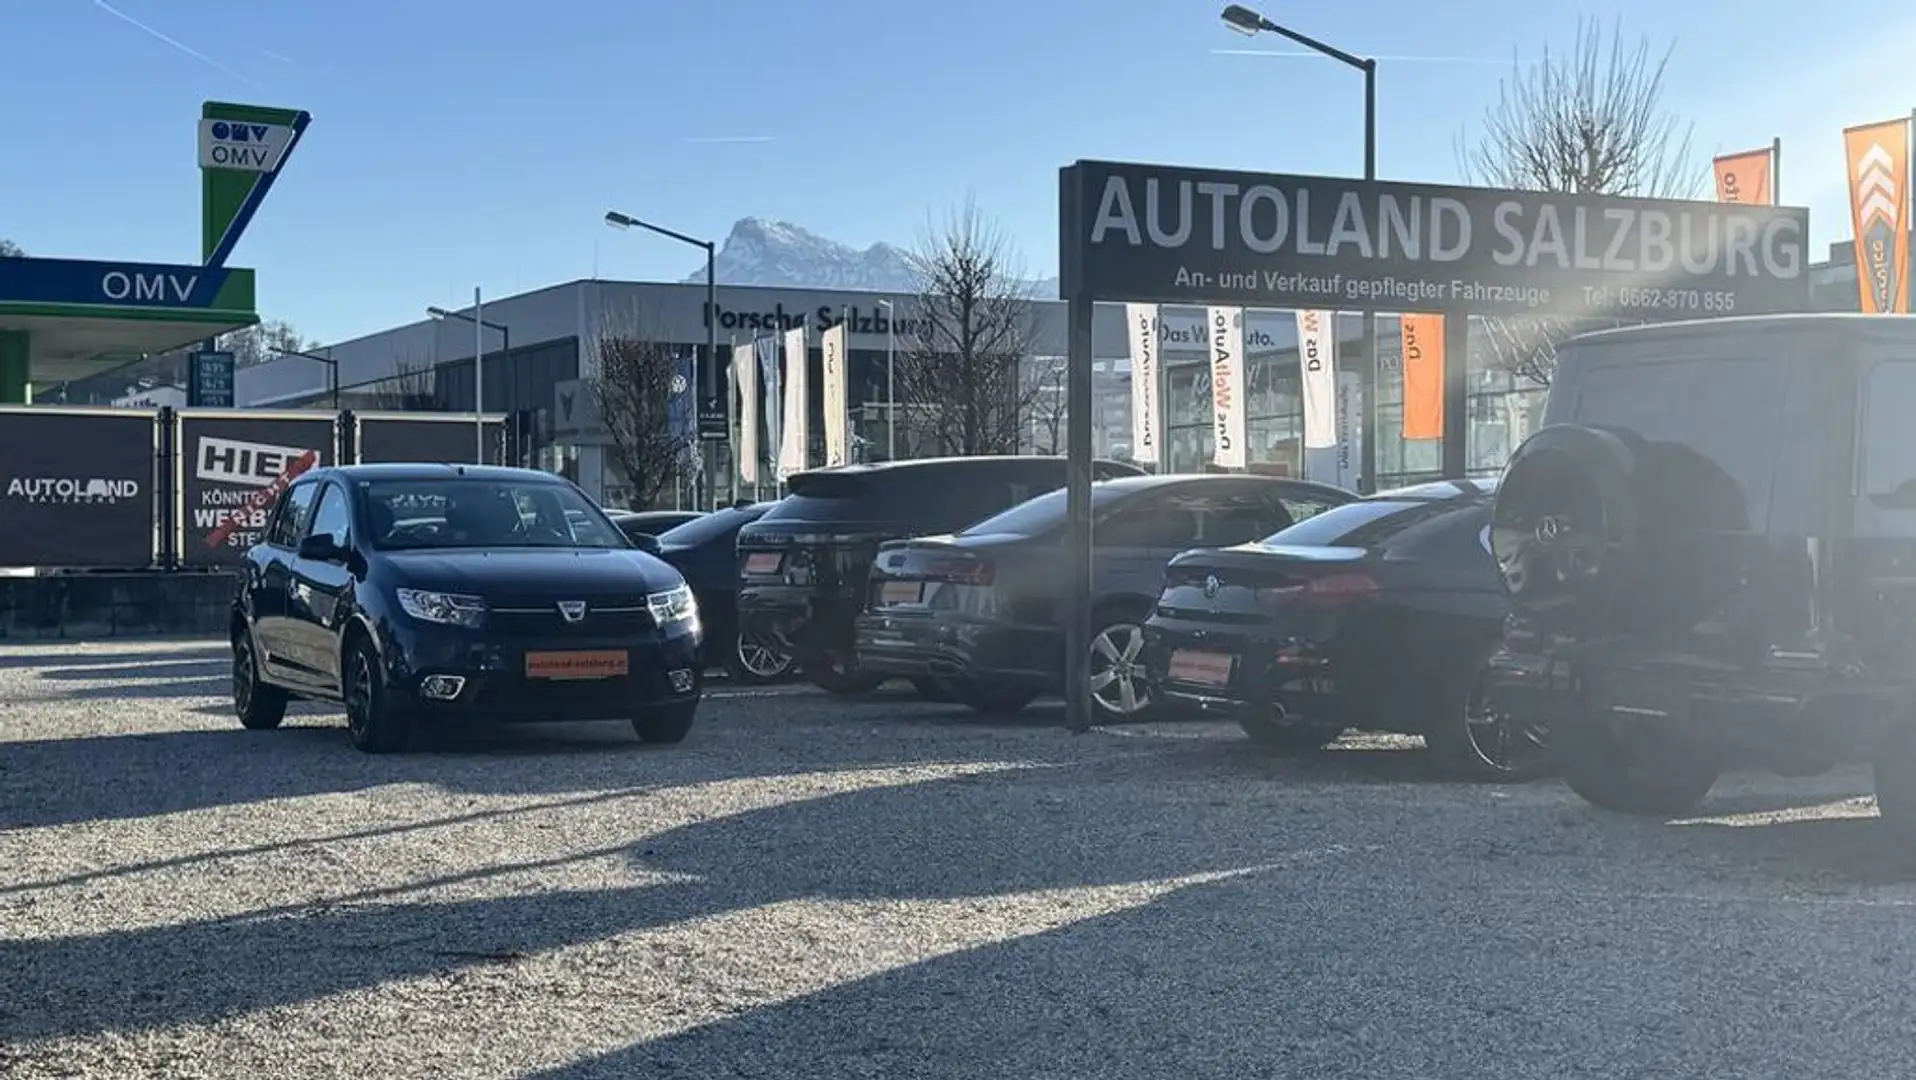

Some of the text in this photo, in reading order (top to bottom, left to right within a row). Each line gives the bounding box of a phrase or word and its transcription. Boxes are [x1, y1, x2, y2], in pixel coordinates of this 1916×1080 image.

[211, 146, 269, 168] OMV
[1090, 174, 1800, 279] AUTOLAND SALZBURG
[102, 271, 198, 302] OMV
[1174, 265, 1212, 288] An-
[1219, 269, 1257, 290] und
[1262, 270, 1342, 294] Verkauf
[1346, 275, 1446, 302] gepflegter
[1450, 279, 1550, 307] Fahrzeuge
[1619, 286, 1699, 310] 0662-870
[1704, 290, 1735, 310] 855
